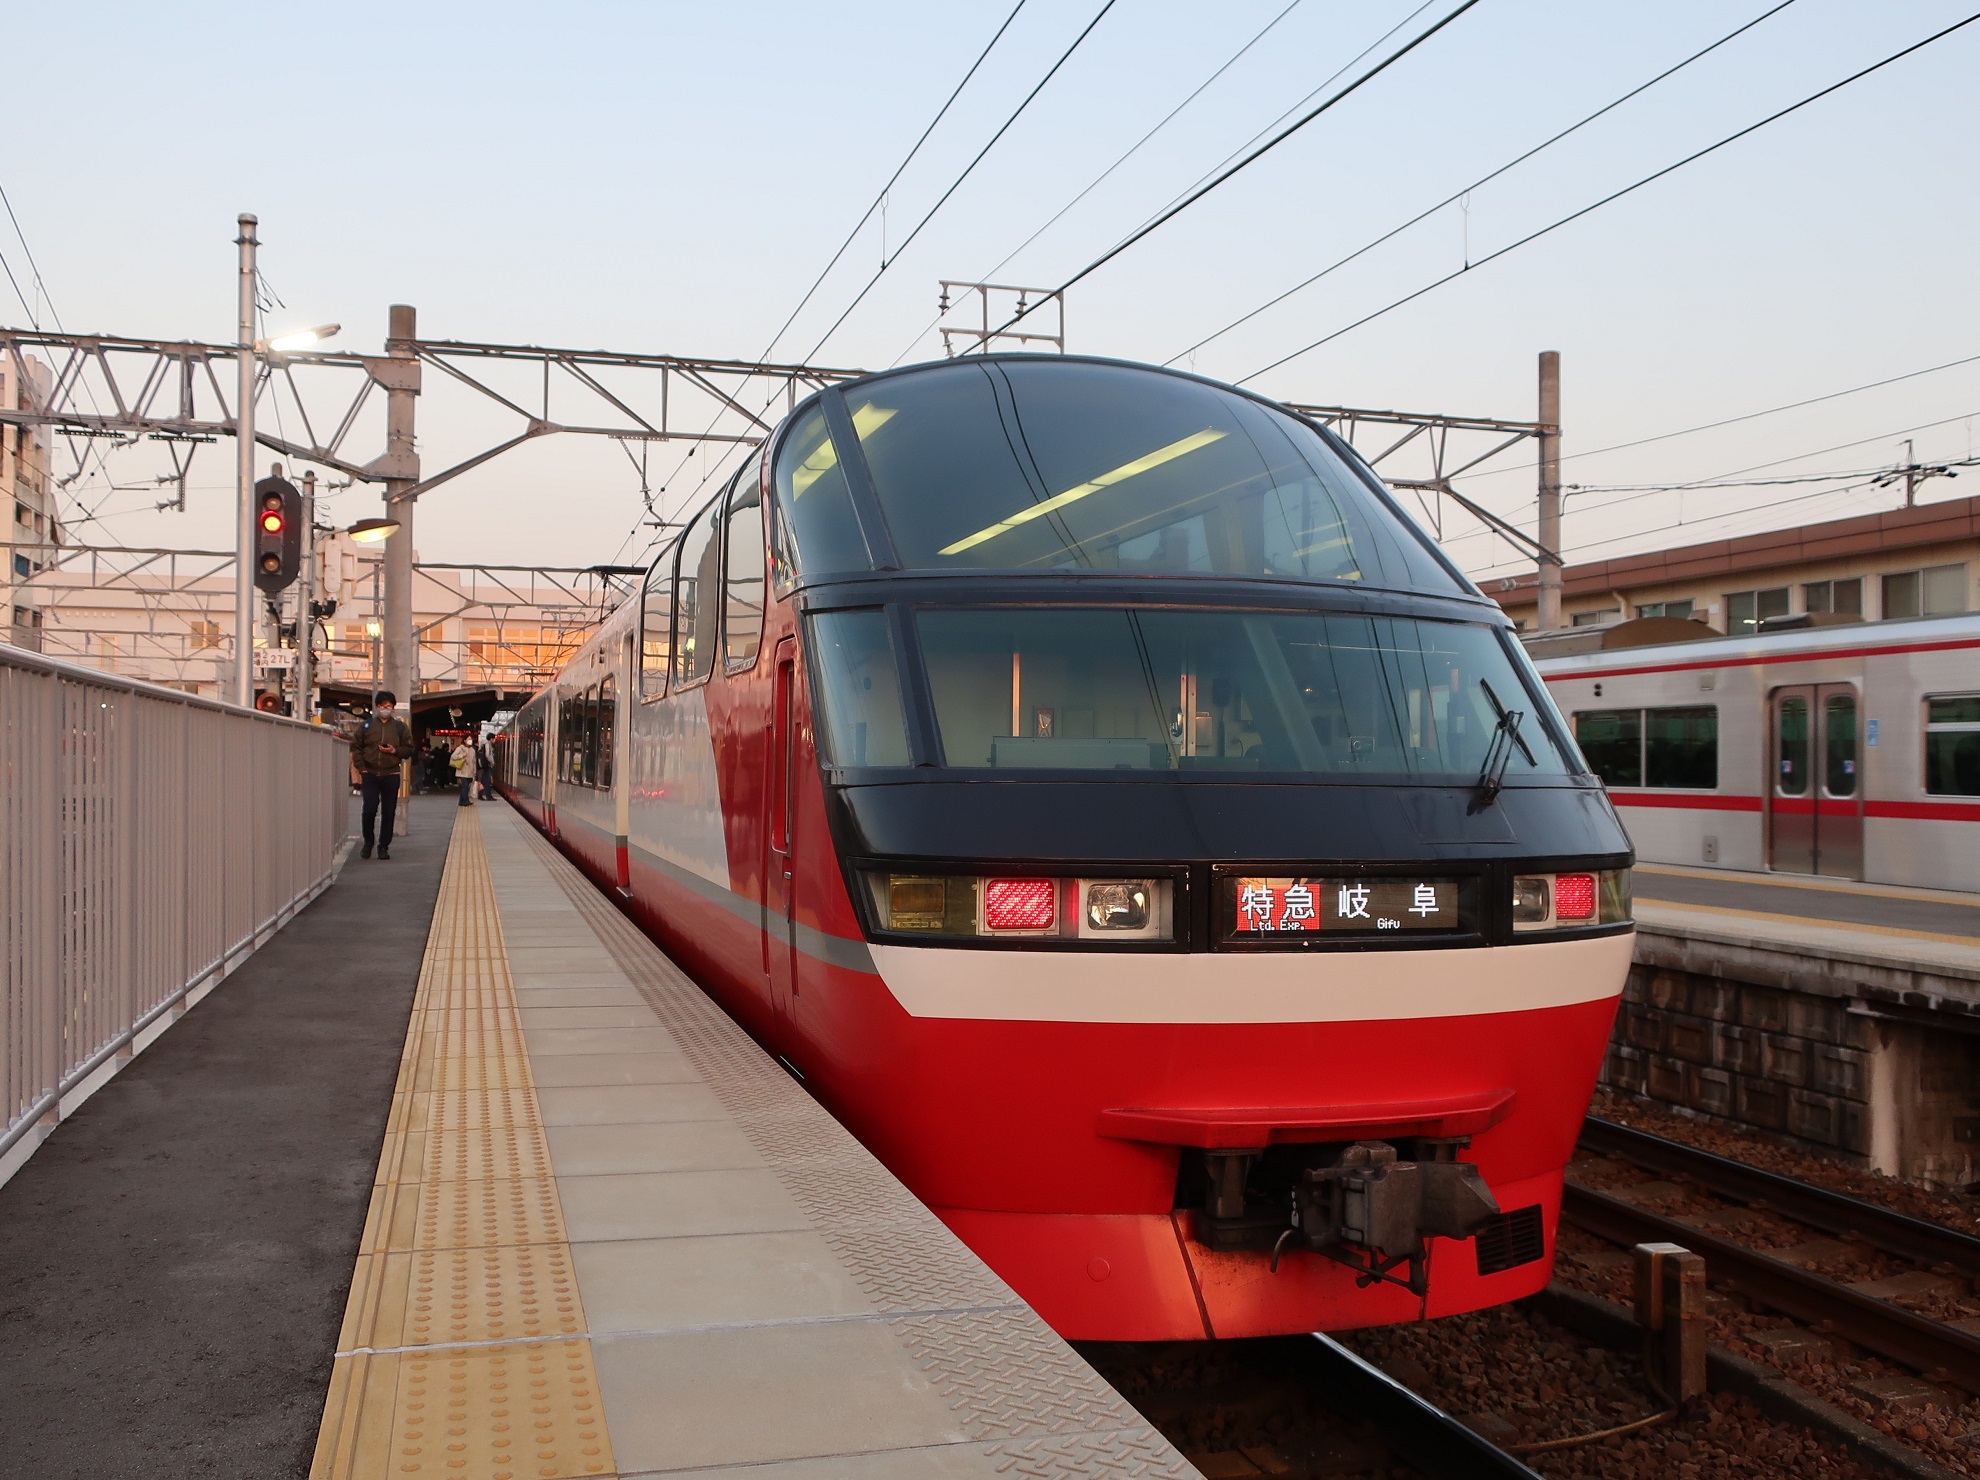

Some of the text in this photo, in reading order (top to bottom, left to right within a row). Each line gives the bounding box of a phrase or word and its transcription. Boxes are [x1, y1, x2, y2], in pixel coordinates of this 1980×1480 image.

[270, 654, 290, 664] 27L
[1241, 884, 1315, 919] 特急
[1250, 920, 1305, 931] Ltd. Exp.
[1377, 918, 1401, 929] Gifu
